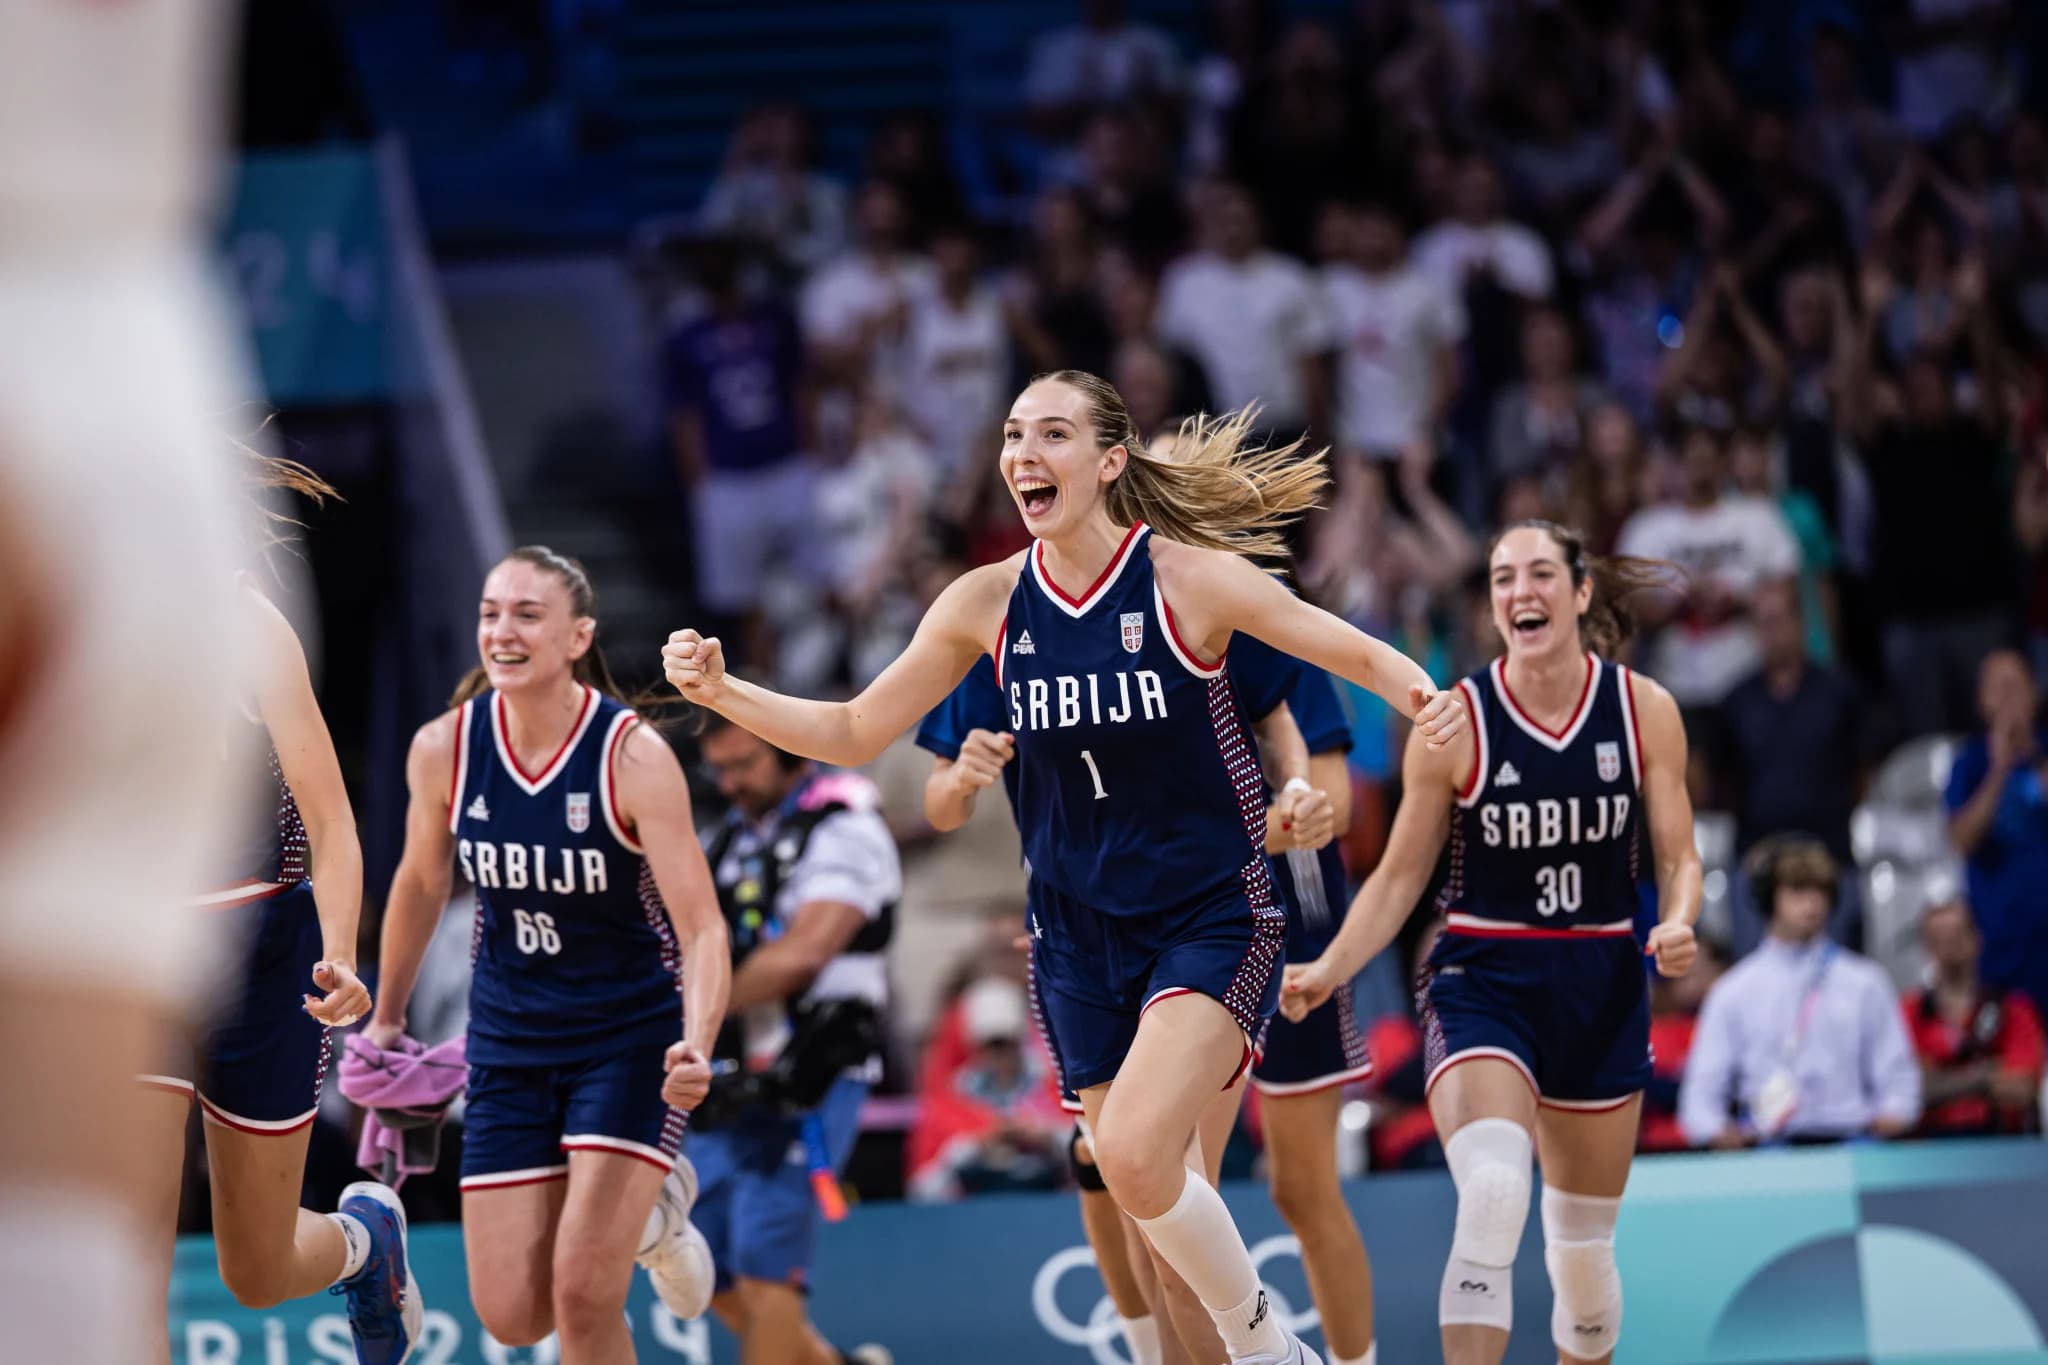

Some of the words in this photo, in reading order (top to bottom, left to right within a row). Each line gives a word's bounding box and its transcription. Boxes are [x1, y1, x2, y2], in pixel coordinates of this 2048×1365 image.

[1010, 670, 1169, 731] SRBIJA
[1080, 750, 1110, 800] 1
[1480, 793, 1630, 849] SRBIJA
[458, 838, 608, 894] SRBIJA
[1535, 861, 1582, 917] 30
[513, 909, 562, 955] 66
